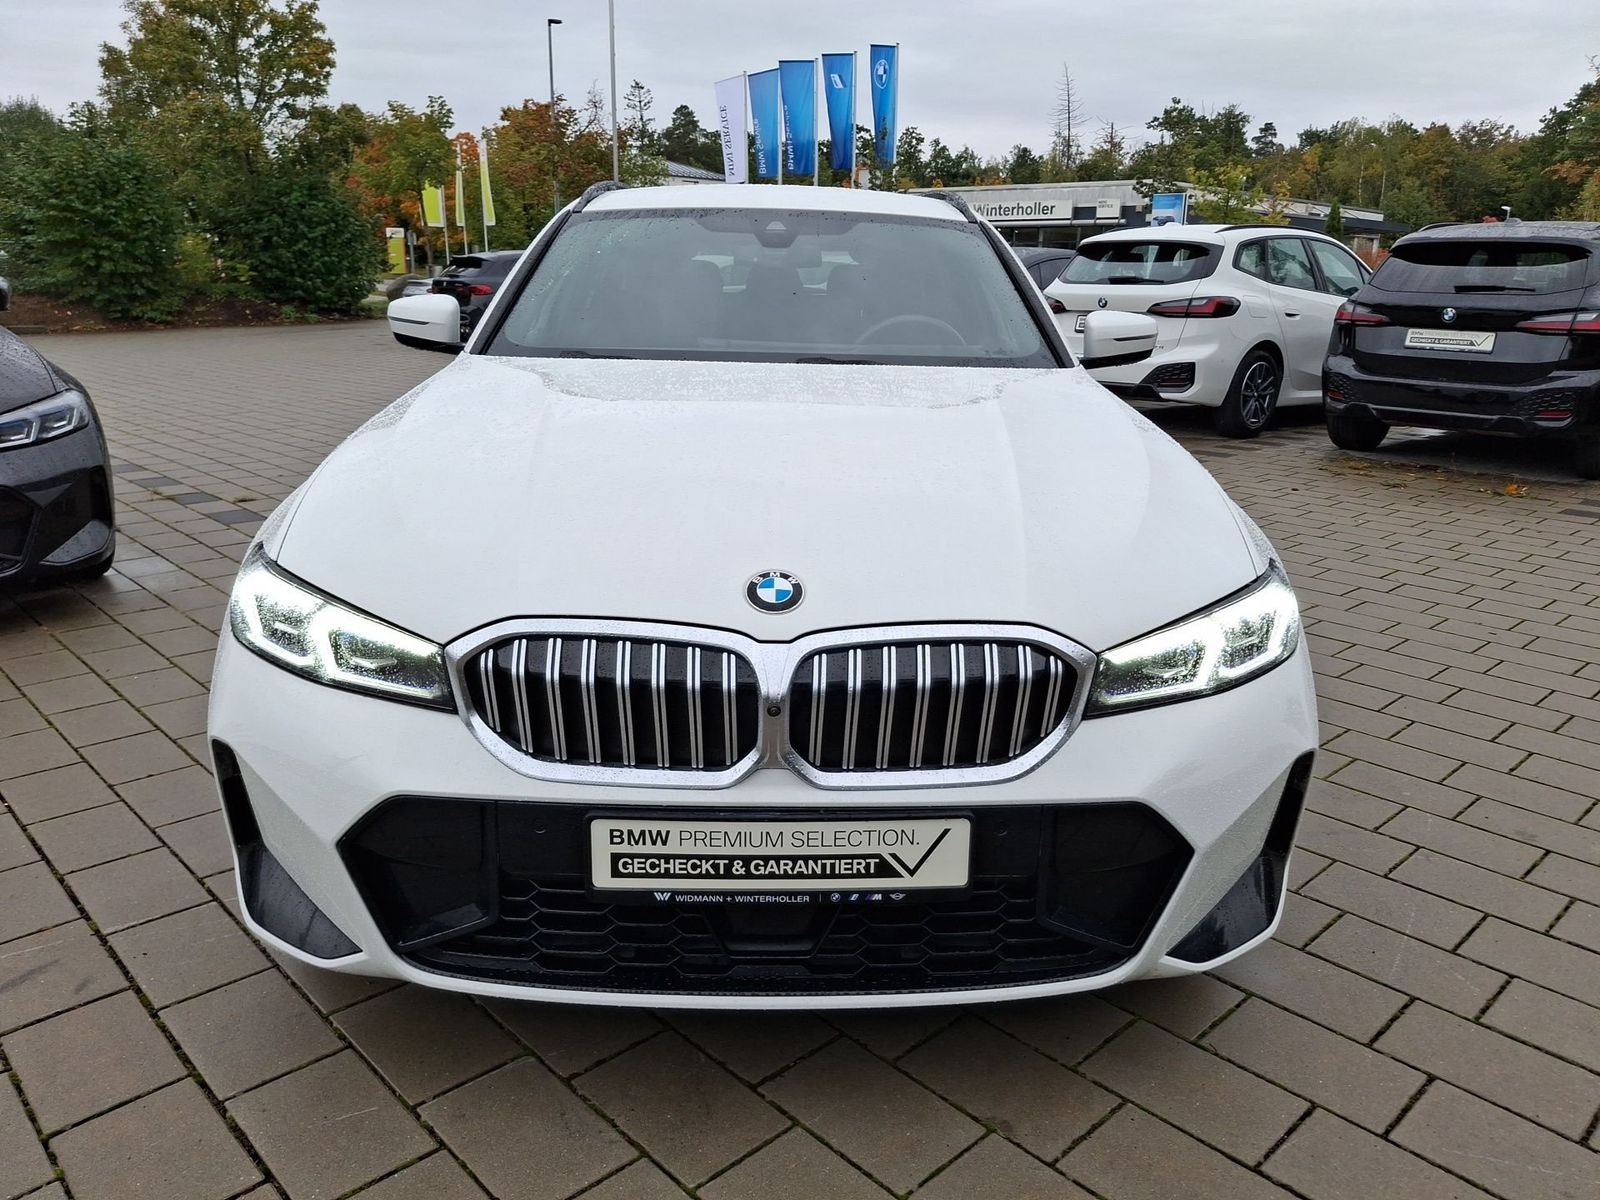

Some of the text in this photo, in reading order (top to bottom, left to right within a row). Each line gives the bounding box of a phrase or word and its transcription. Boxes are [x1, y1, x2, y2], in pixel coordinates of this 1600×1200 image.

[973, 202, 1056, 216] Winterholler
[752, 572, 798, 583] BMW
[609, 829, 670, 846] BMW
[679, 830, 784, 848] PREMIUM
[618, 858, 879, 875] GECHECKT & GARANTIERT
